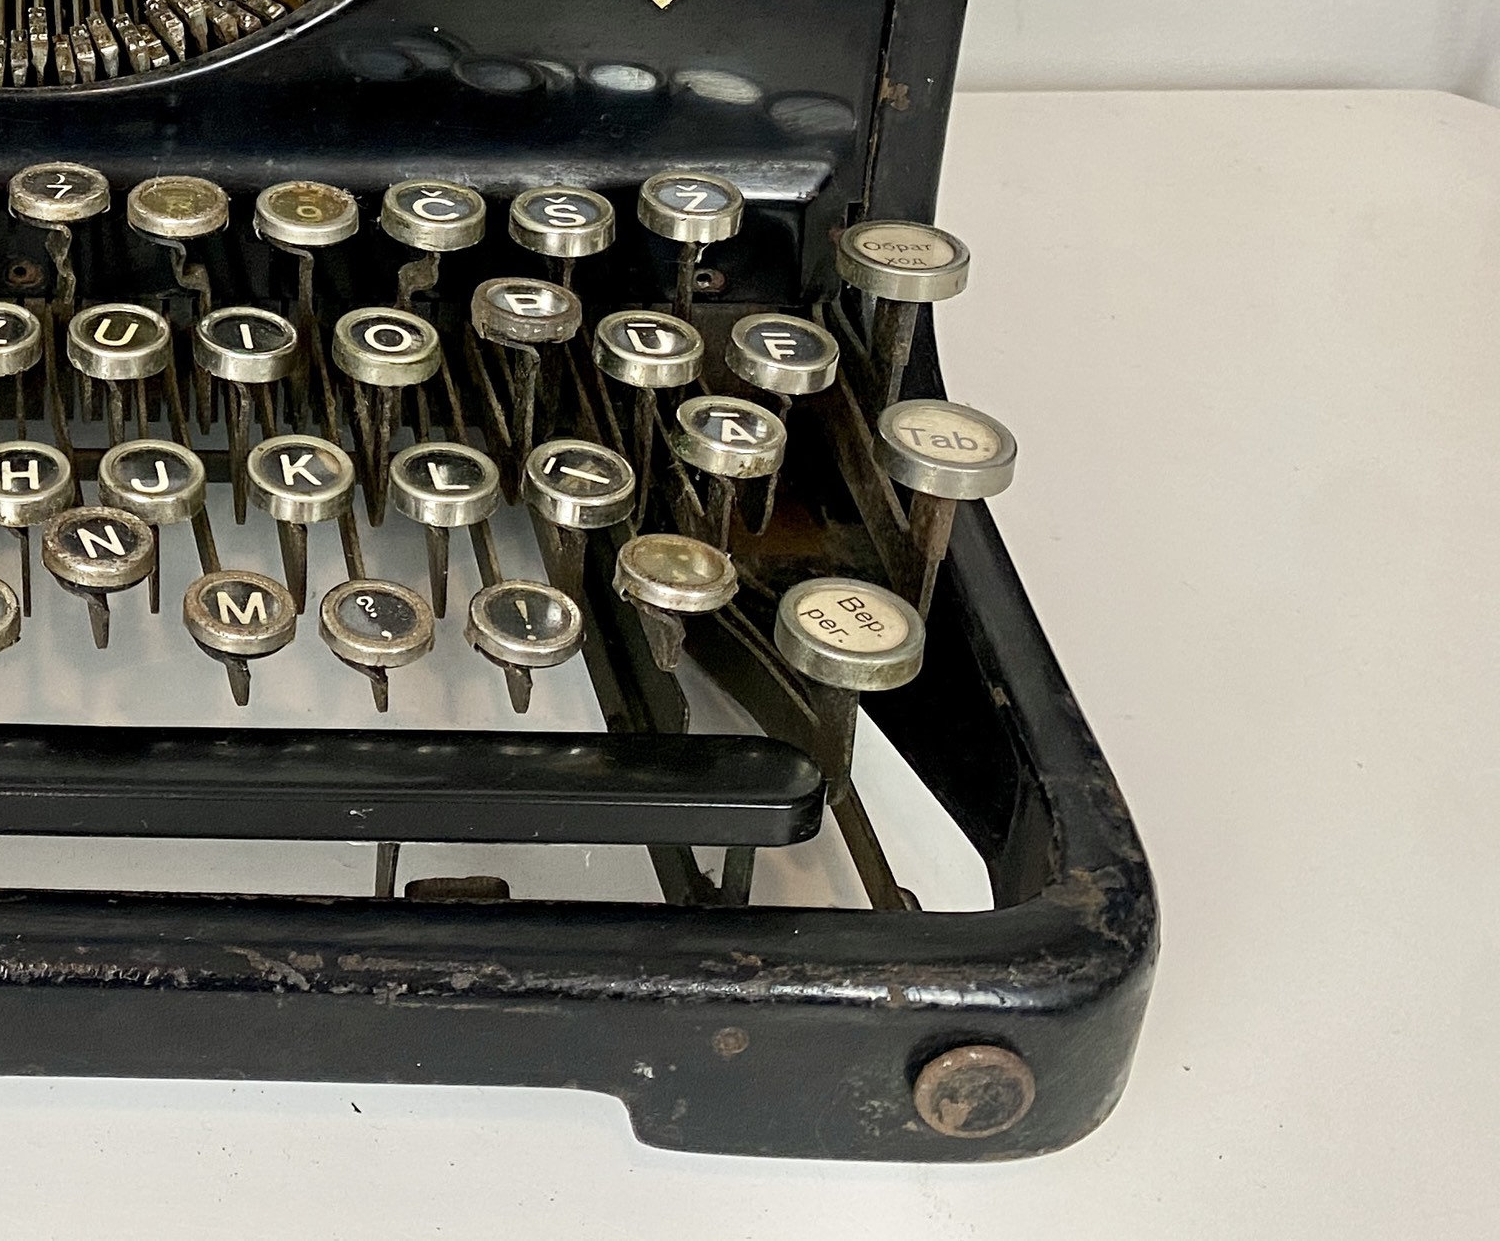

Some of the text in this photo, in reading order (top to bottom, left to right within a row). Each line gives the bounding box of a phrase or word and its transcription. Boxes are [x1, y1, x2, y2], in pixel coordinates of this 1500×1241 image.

[46, 184, 73, 199] 7
[884, 256, 928, 267] ход
[93, 318, 139, 346] U
[363, 323, 413, 353] O
[899, 426, 991, 453] Tab.
[0, 459, 41, 491] H
[130, 459, 170, 494] J
[278, 453, 323, 486] K
[427, 461, 471, 491] L
[76, 523, 127, 560] N
[216, 590, 268, 626] M
